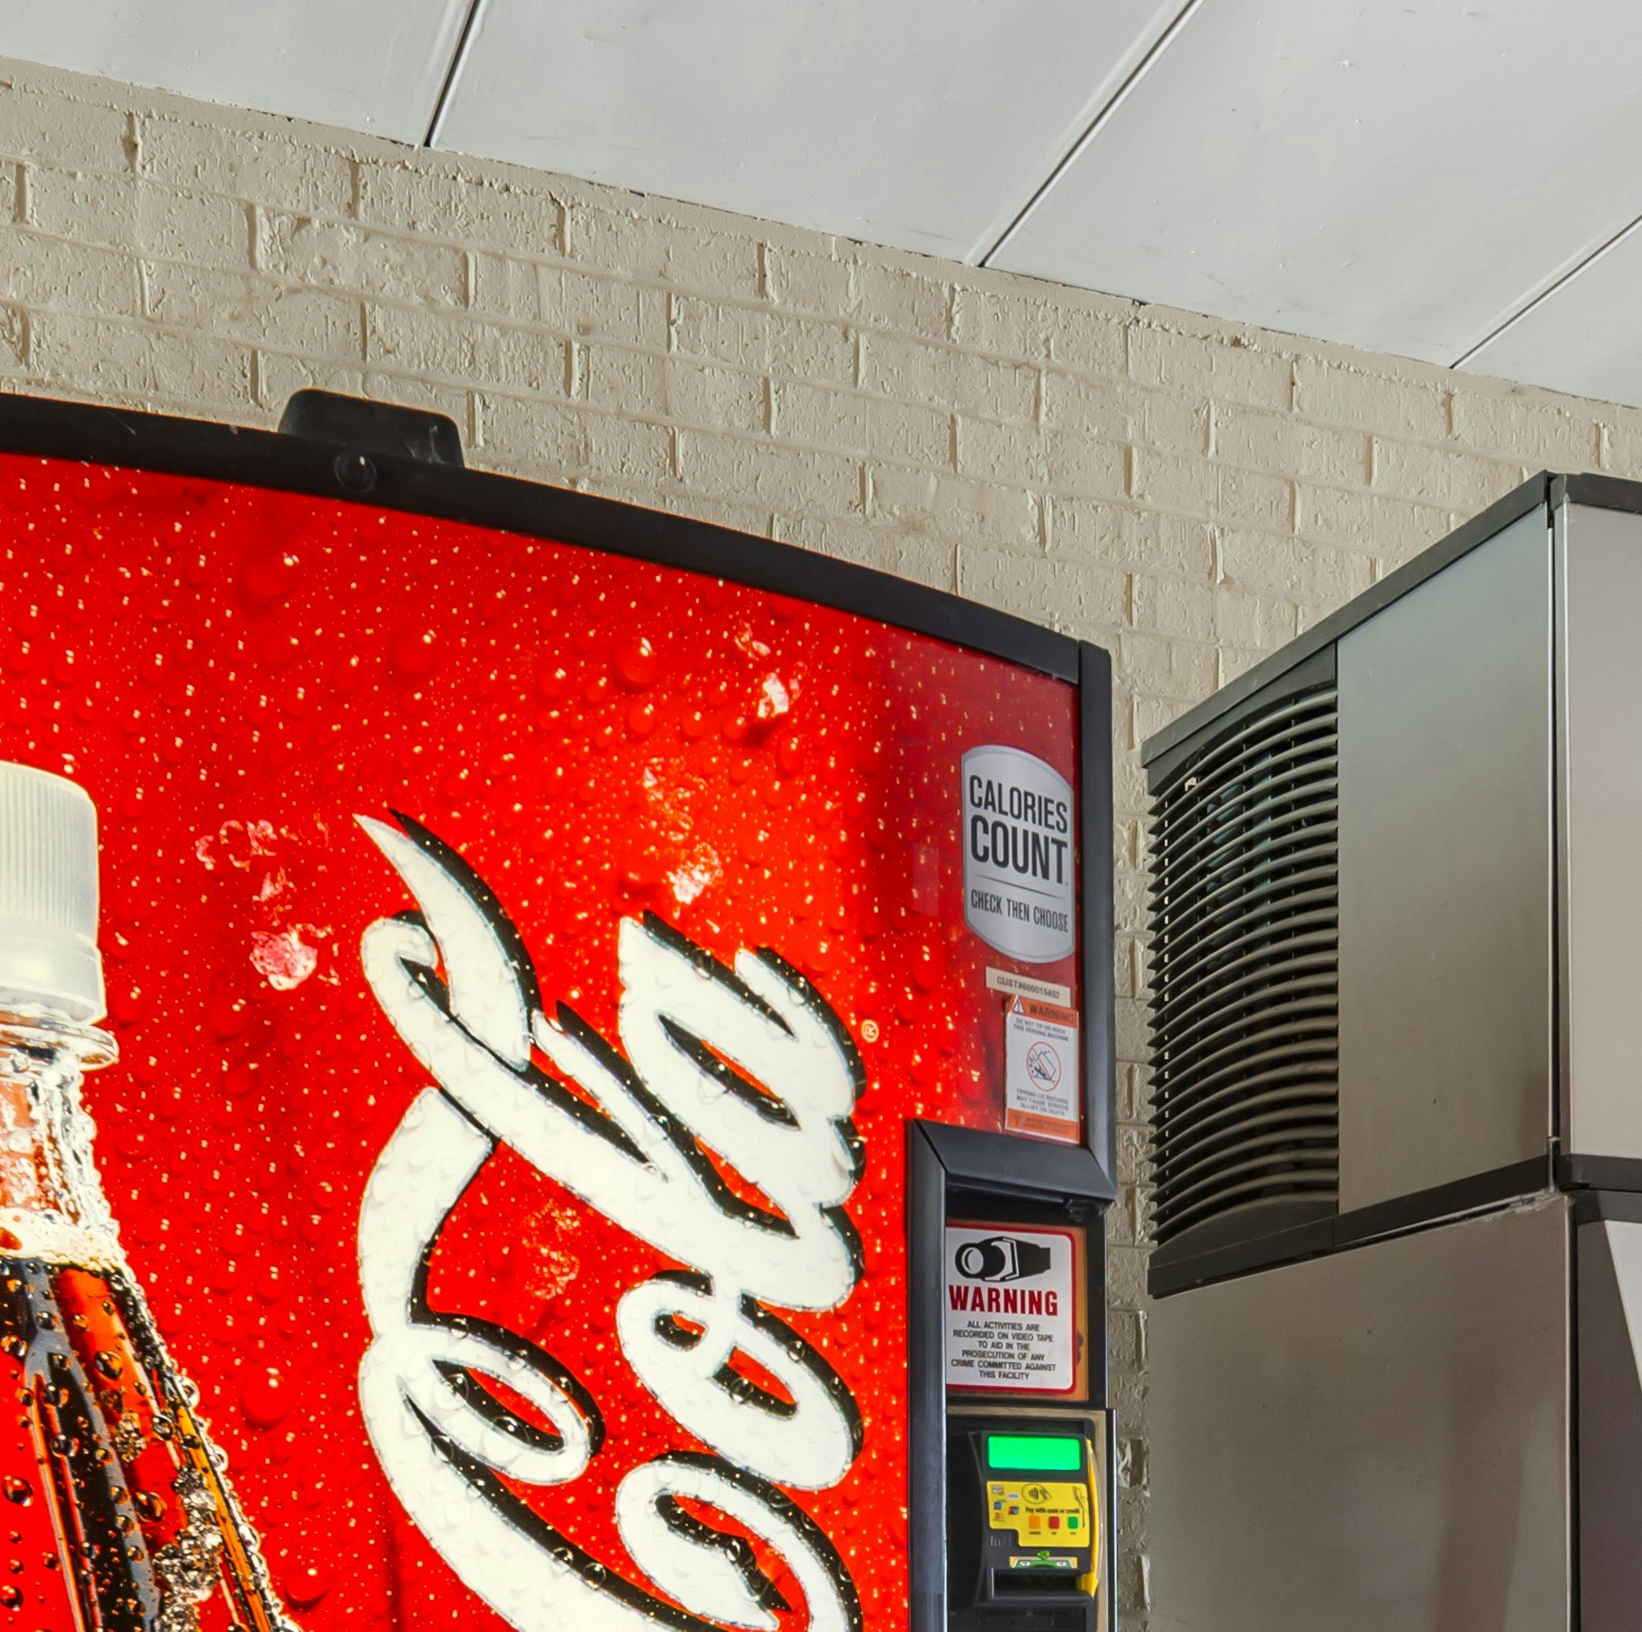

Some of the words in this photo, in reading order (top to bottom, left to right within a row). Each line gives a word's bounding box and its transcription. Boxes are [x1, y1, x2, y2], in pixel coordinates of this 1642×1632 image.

[969, 774, 1068, 834] CALORIES
[970, 814, 1068, 885] COUNT
[971, 889, 1003, 915] CHECK
[1006, 898, 1030, 923] THEN
[1033, 905, 1069, 933] CHOOSE
[948, 1284, 1059, 1317] WARNING
[967, 1320, 981, 1329] ALL
[984, 1321, 1023, 1331] ACTIVITIES
[1026, 1323, 1040, 1332] ARE
[953, 1329, 995, 1339] RECORDED
[997, 1331, 1009, 1339] ON
[1011, 1332, 1034, 1341] VIDEO
[1037, 1334, 1054, 1343] TAPE
[977, 1340, 988, 1348] TO
[990, 1341, 1003, 1350] AID
[1005, 1342, 1014, 1350] IN
[1016, 1343, 1031, 1351] THE
[961, 1349, 1015, 1359] PROSECUTION
[1017, 1352, 1028, 1361] OF
[1030, 1353, 1045, 1361] ANY
[950, 1358, 975, 1368] CRIME
[977, 1360, 1022, 1370] COMMITTED
[1024, 1363, 1056, 1372] AGAINST
[978, 1369, 996, 1379] THIS
[998, 1371, 1030, 1381] FACILITY
